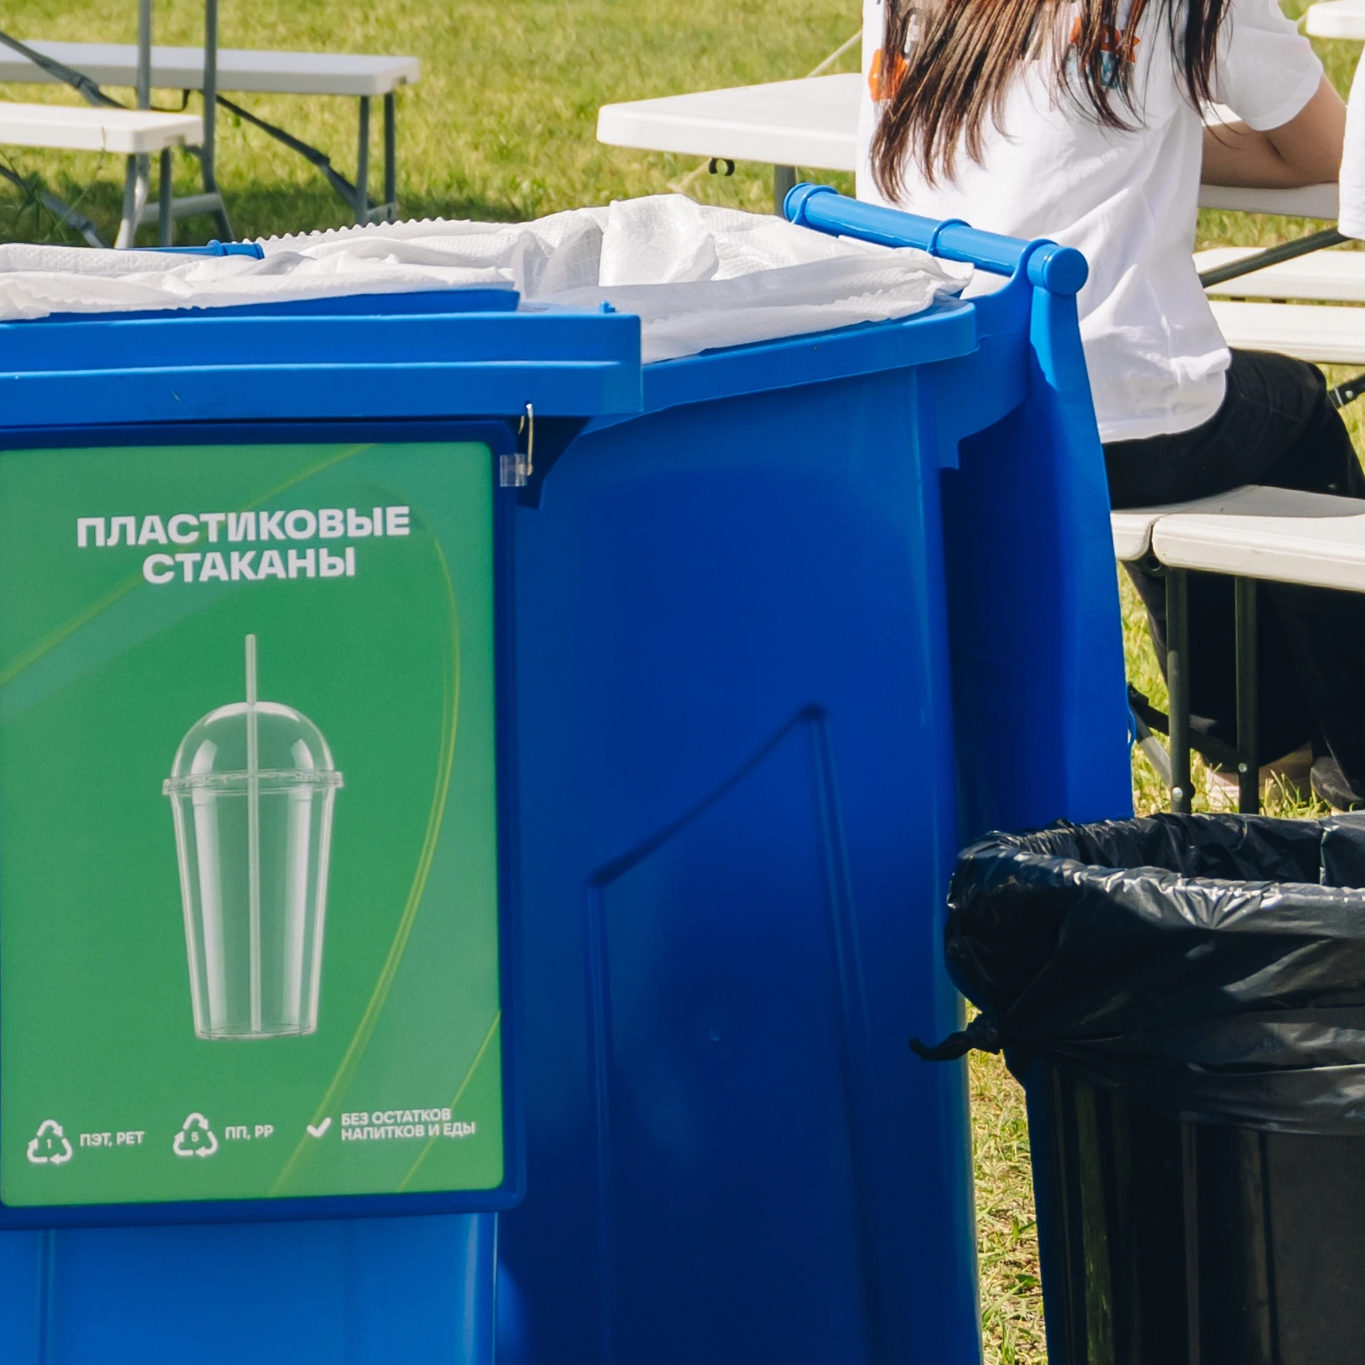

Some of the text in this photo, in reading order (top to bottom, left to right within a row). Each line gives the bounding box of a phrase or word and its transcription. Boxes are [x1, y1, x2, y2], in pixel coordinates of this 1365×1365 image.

[77, 506, 410, 547] ПЛАСТИКОВЫЕ
[142, 547, 355, 584] СТАКАНЫ
[341, 1108, 452, 1126] БЕЗ ОСТАТКОВ
[79, 1131, 145, 1147] ПЭТ, PET
[225, 1126, 251, 1140] ПП,
[341, 1122, 476, 1141] НАПИТКОВ И ЕДЫ
[46, 1138, 52, 1149] 1
